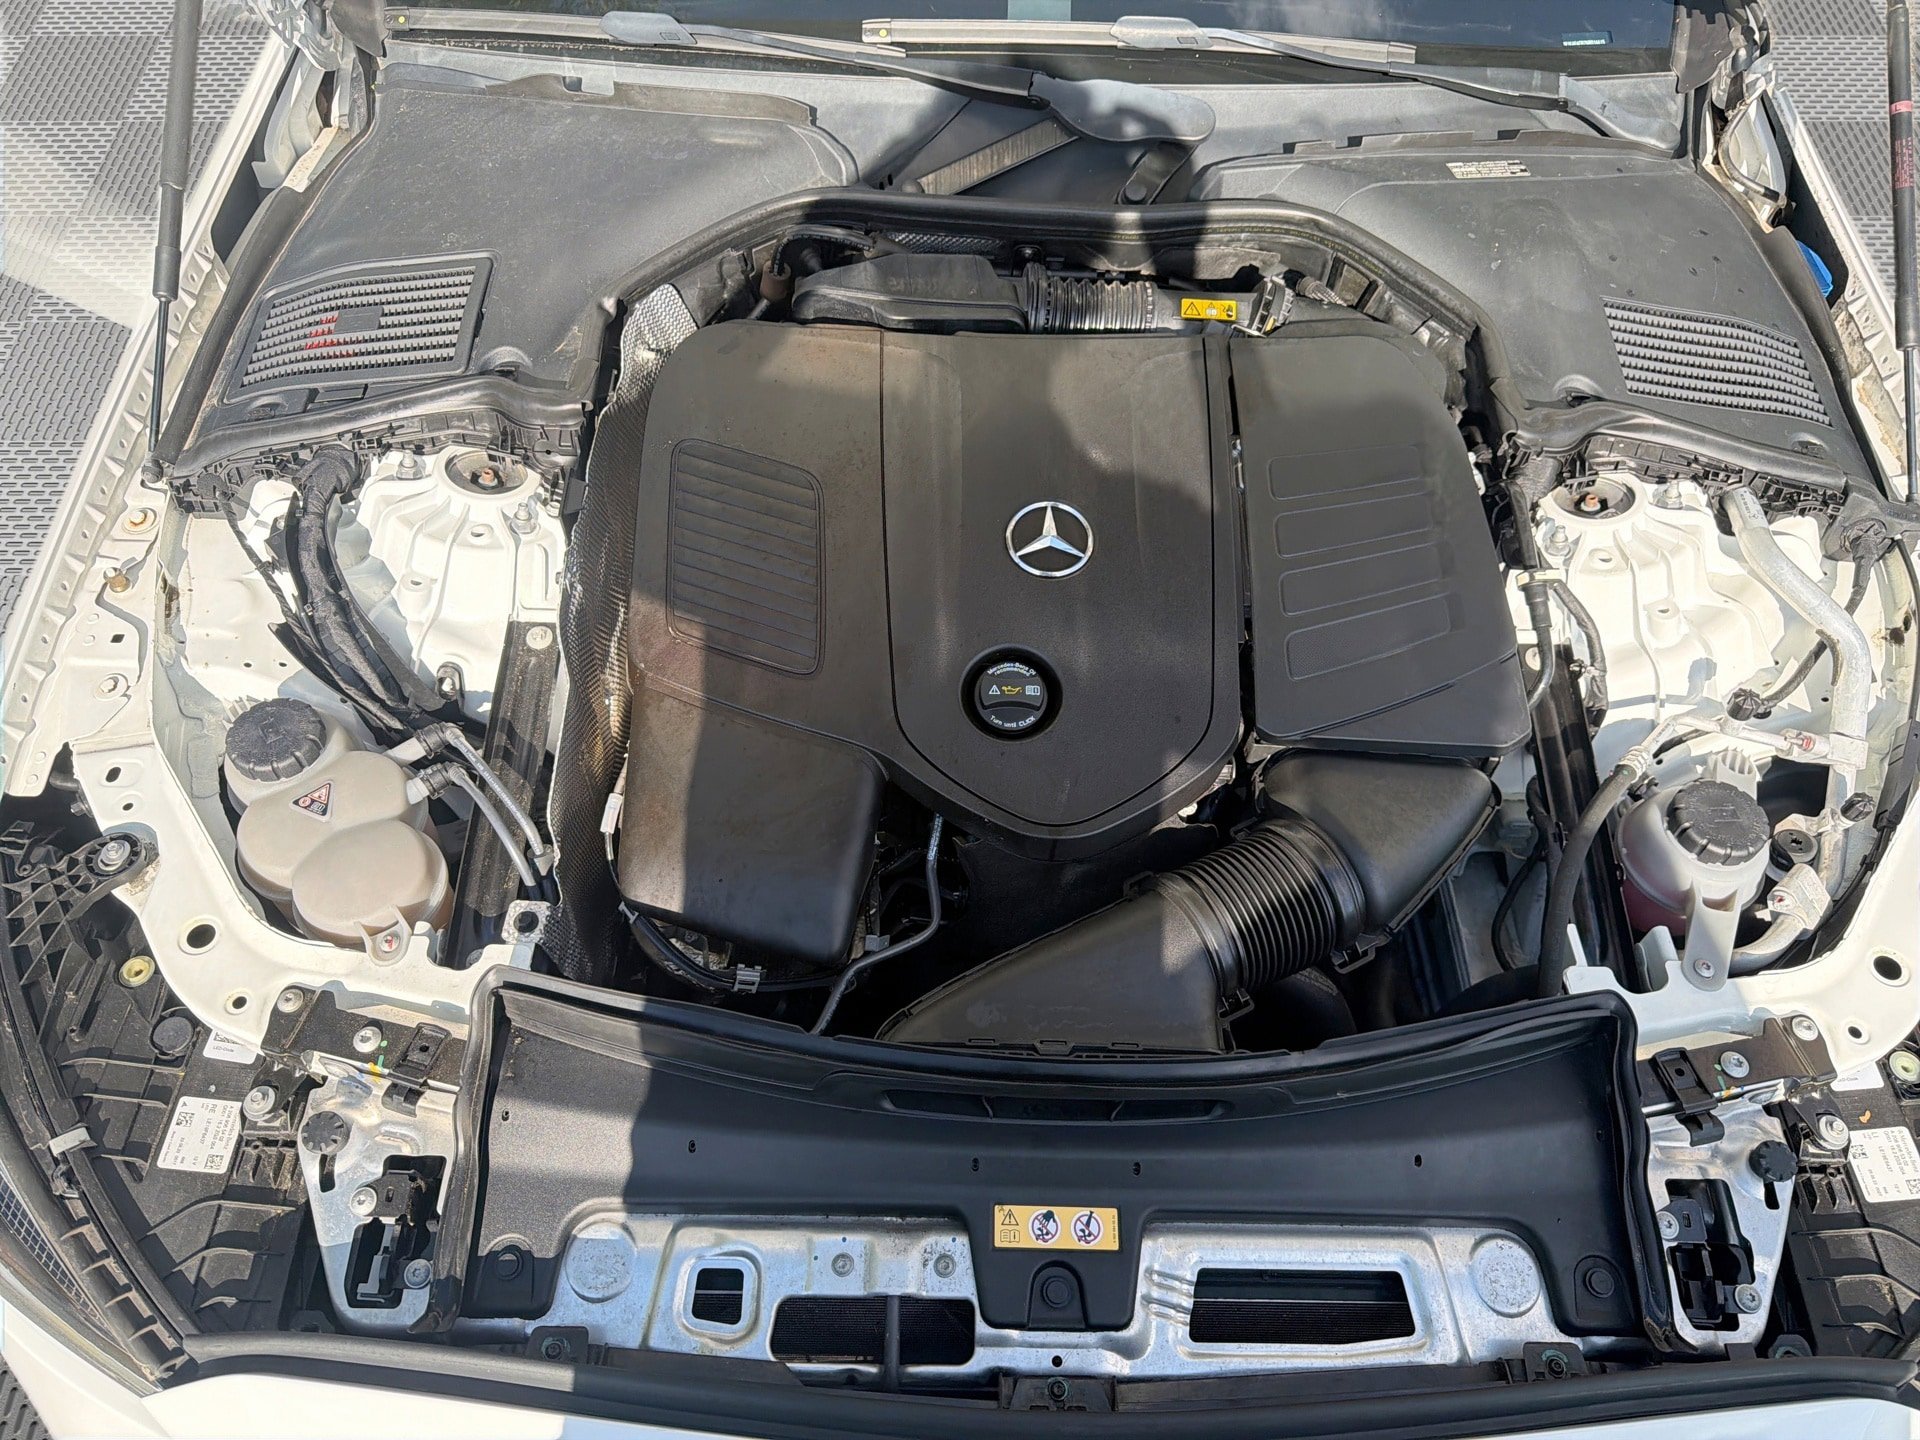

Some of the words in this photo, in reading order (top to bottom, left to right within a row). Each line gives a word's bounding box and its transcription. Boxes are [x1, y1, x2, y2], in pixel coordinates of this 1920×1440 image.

[987, 662, 1028, 674] Mercedes-Benz
[994, 668, 1031, 676] recommended
[990, 715, 1002, 726] Turn
[1019, 716, 1036, 727] CLICK
[208, 1103, 218, 1114] RE
